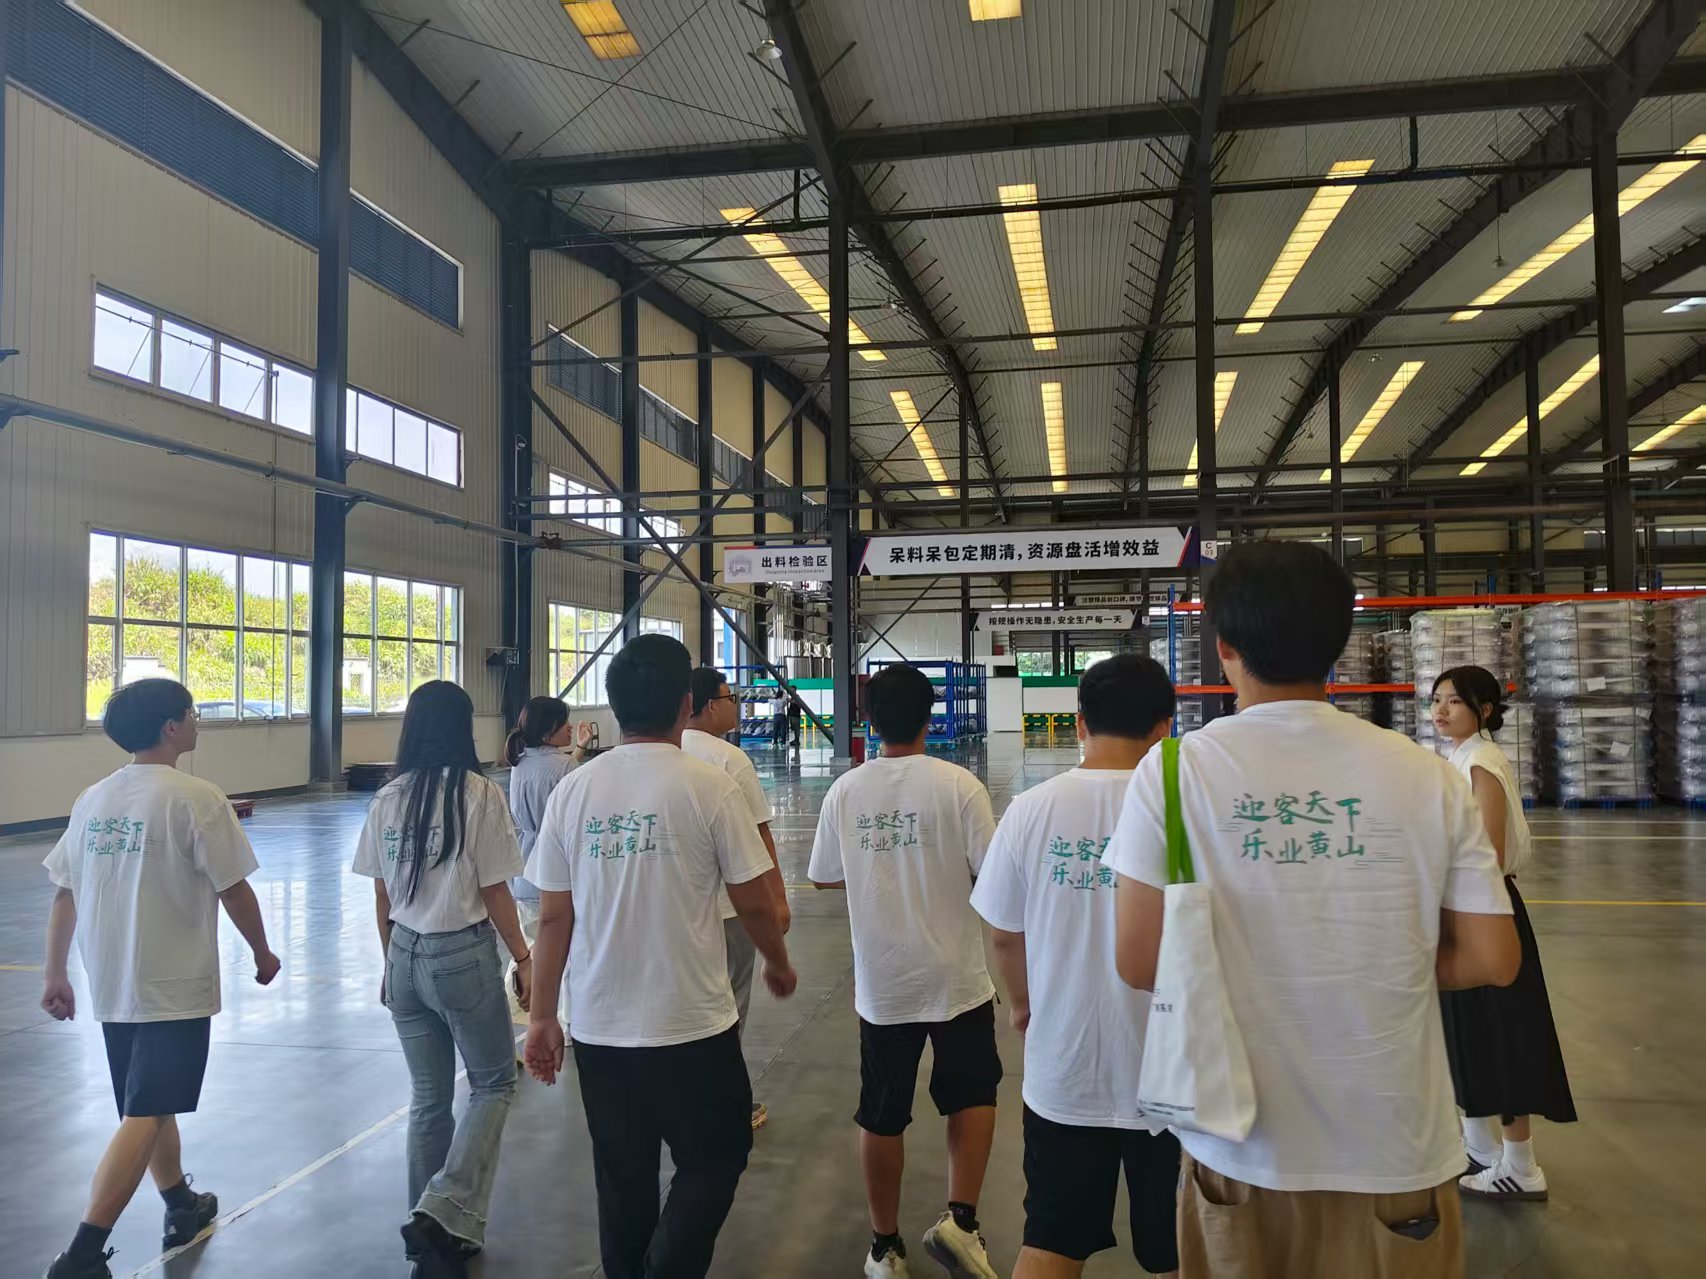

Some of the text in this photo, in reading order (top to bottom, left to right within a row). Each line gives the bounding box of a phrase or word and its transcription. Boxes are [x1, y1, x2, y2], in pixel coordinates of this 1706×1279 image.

[1205, 542, 1212, 550] C
[761, 555, 828, 568] 出料检验区
[856, 810, 918, 833] 迎客天下
[1231, 790, 1362, 832] 迎客天下
[87, 816, 144, 841] 迎客天下
[585, 810, 658, 837] 迎客天下
[87, 836, 142, 856] 乐业黄山
[590, 838, 657, 860] 乐业黄山
[860, 832, 918, 852] 乐业黄山
[1240, 828, 1365, 865] 乐业黄山
[1052, 862, 1119, 891] 乐业黄
